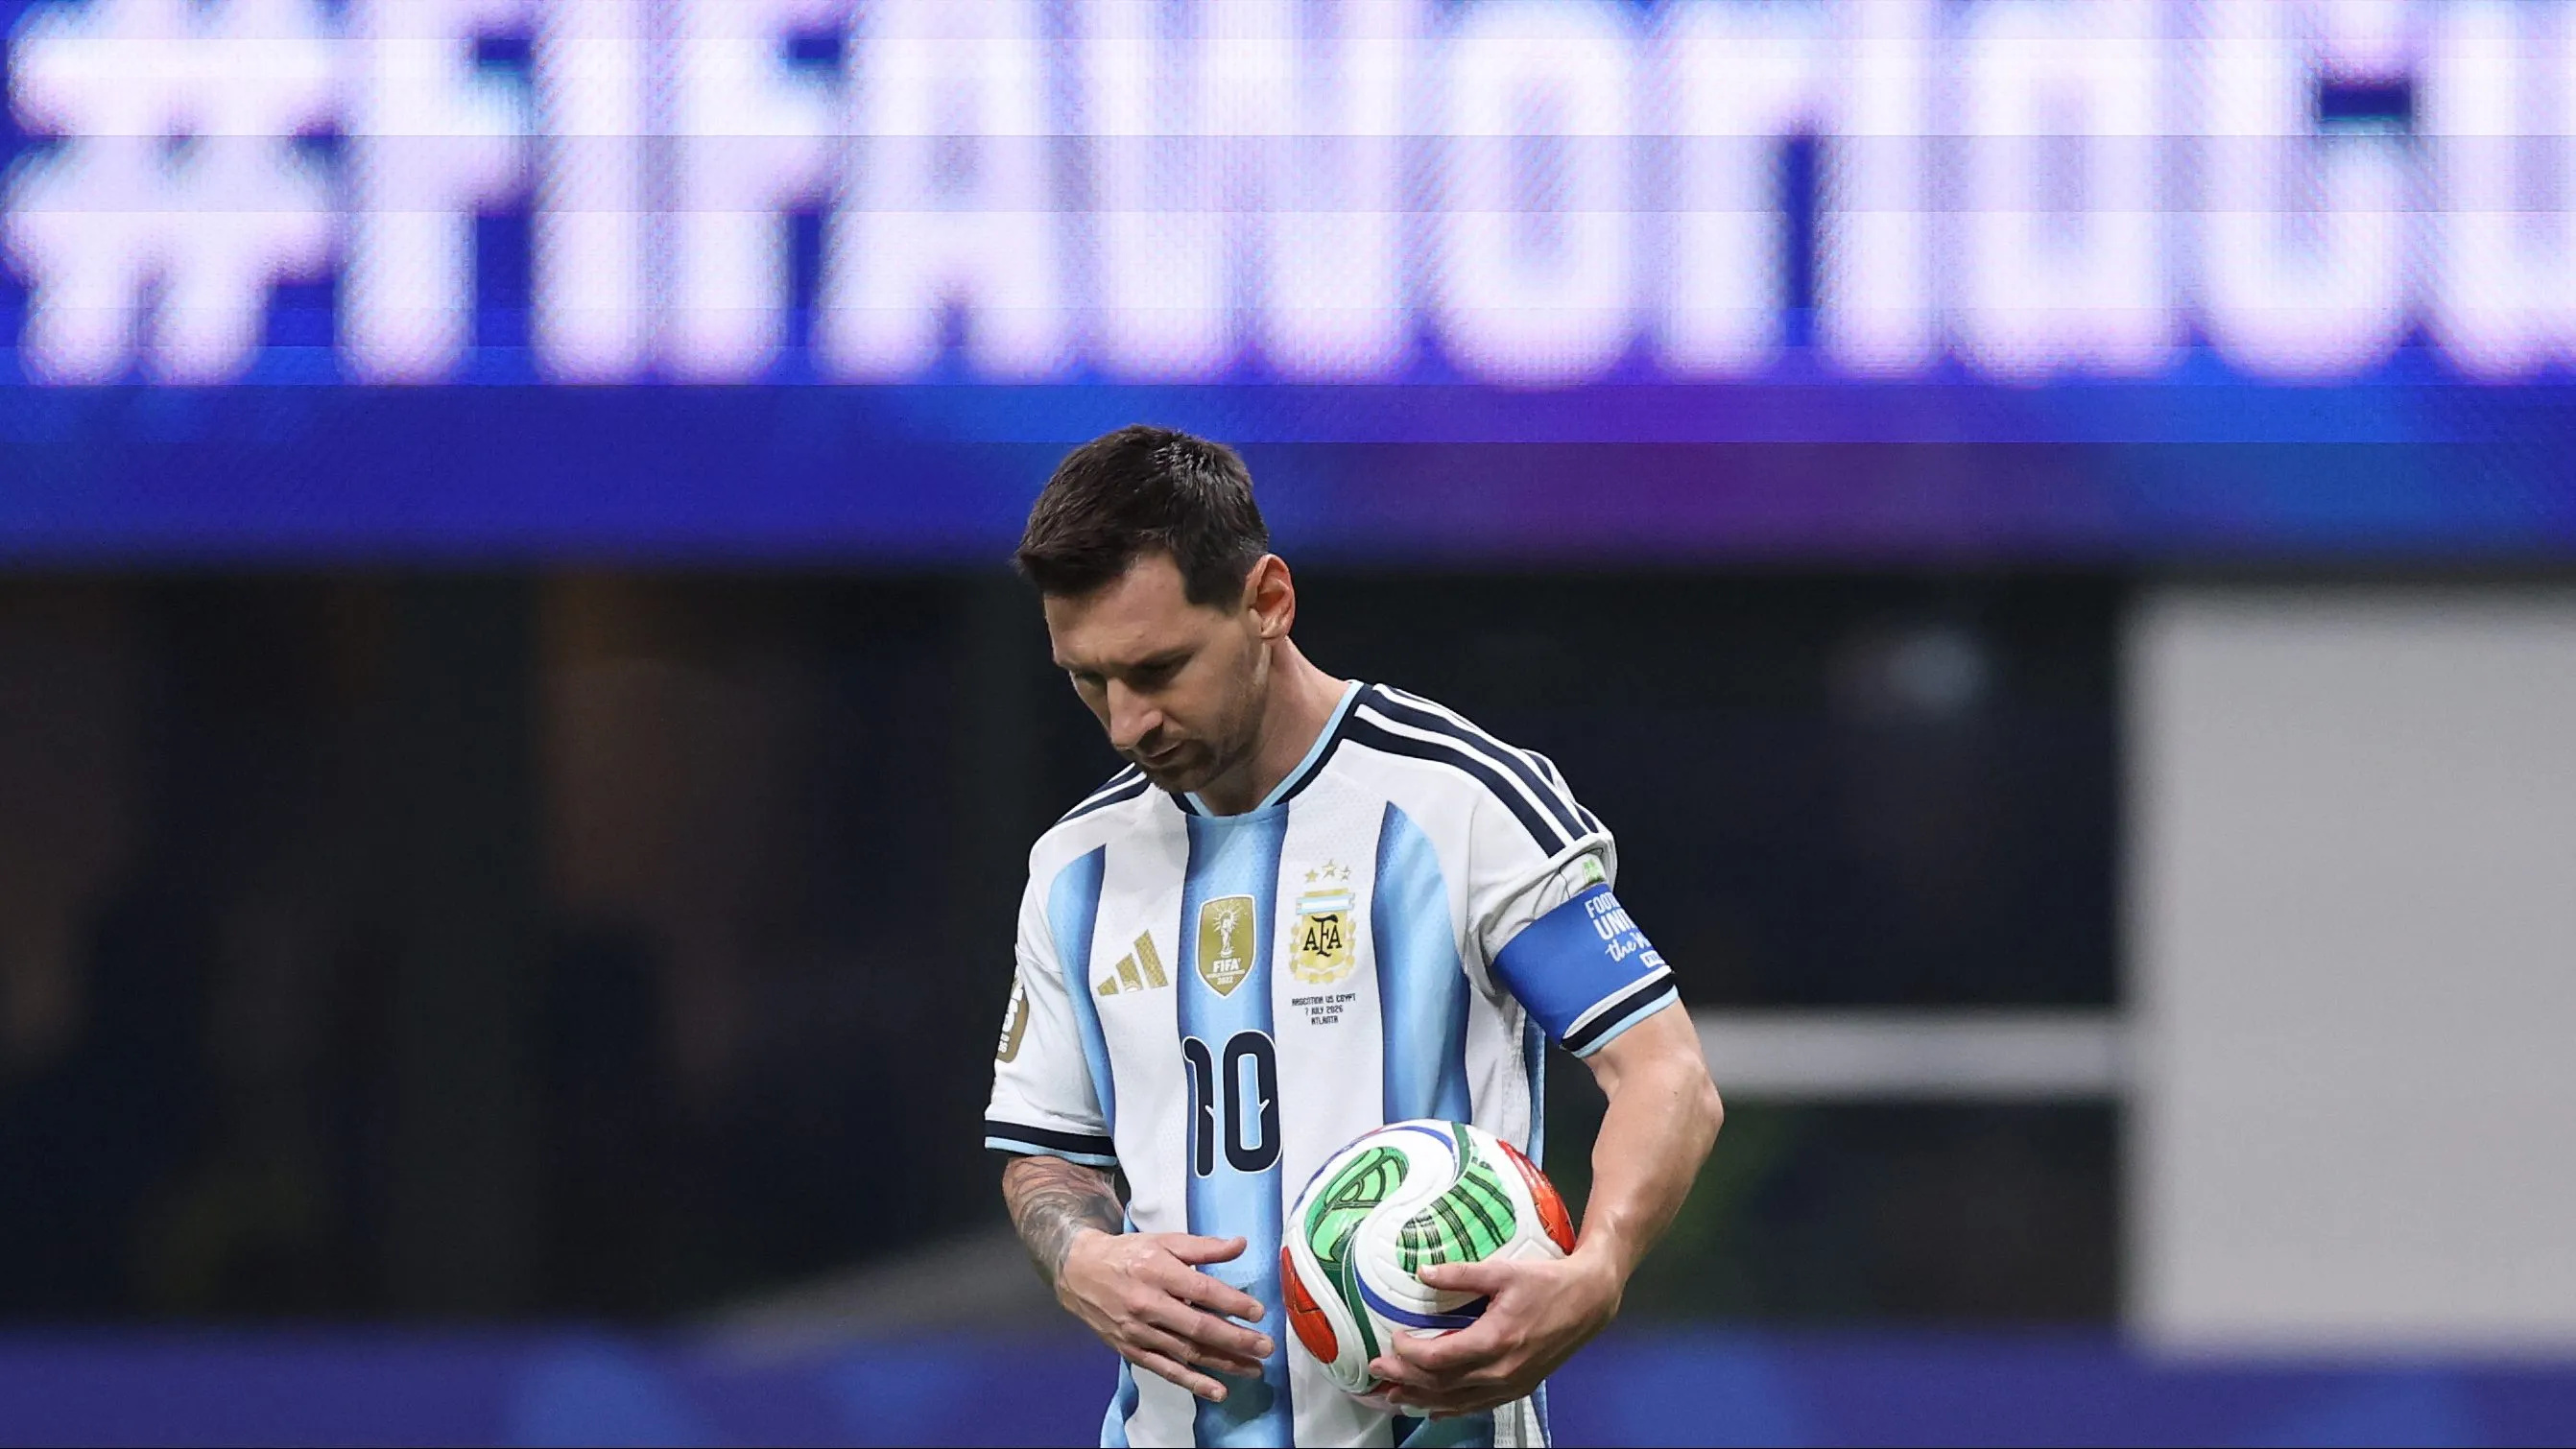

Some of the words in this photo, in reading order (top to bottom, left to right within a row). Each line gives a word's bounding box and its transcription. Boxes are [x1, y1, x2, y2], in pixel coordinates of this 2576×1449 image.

[1585, 892, 1621, 918] FOOT
[1303, 914, 1343, 958] AFA
[1605, 938, 1636, 962] the
[1213, 958, 1240, 973] FIFA
[1182, 1030, 1282, 1178] 10
